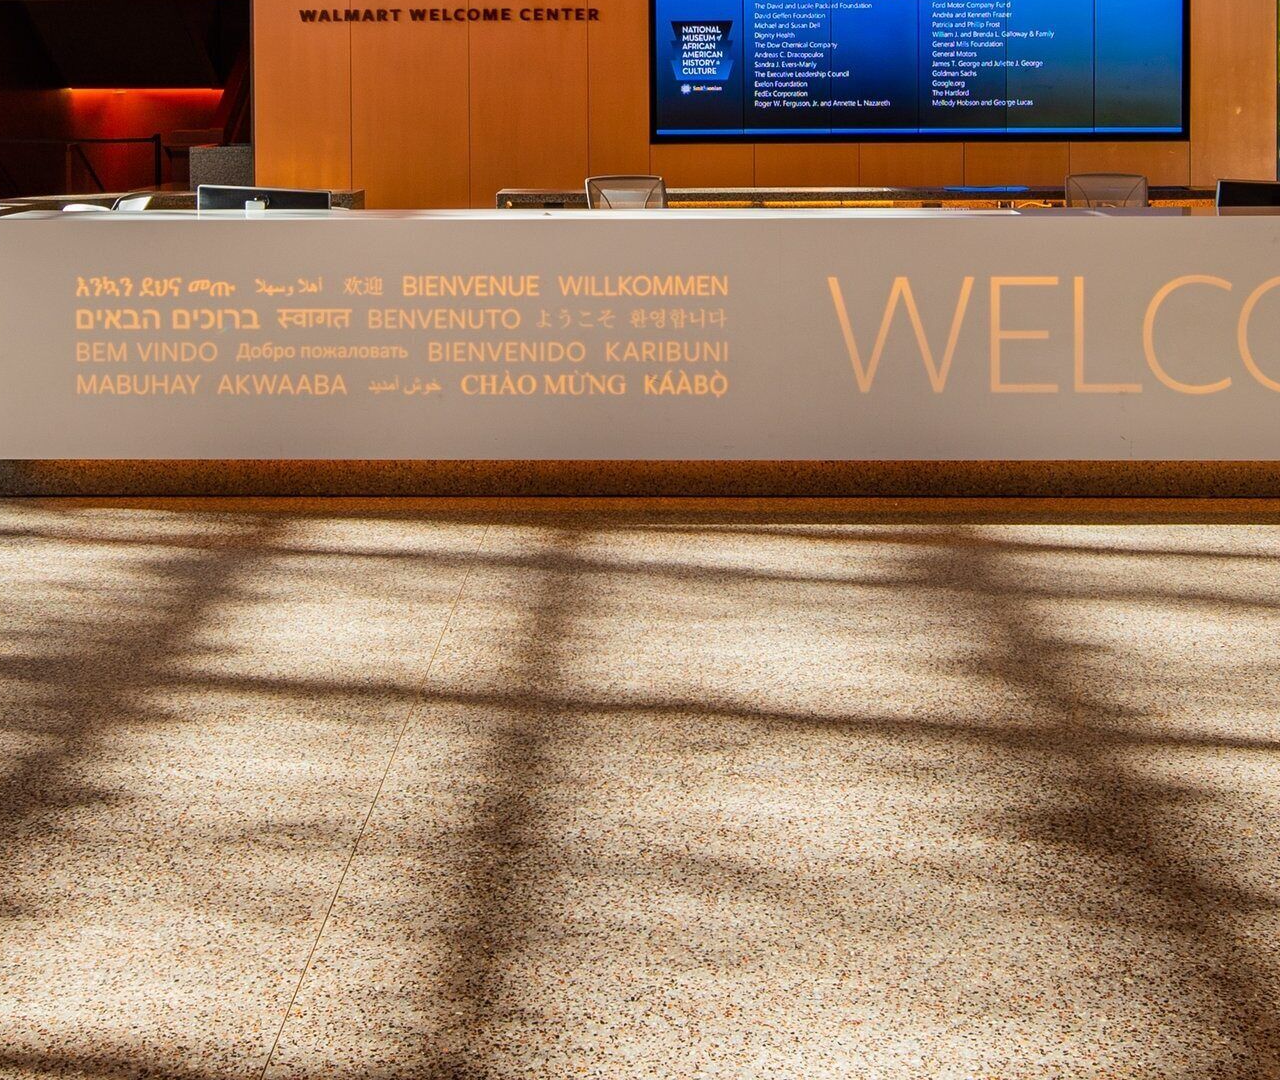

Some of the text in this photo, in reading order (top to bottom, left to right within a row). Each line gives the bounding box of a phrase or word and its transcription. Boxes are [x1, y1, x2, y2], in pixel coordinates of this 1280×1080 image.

[299, 8, 600, 22] WALMART WELCOME CENTER
[966, 2, 994, 10] Company
[754, 32, 774, 40] Dignity
[958, 60, 980, 68] George
[754, 100, 772, 108] Roger
[342, 276, 385, 296] 欢迎
[402, 275, 540, 297] BIENVENUE
[557, 275, 728, 297] WILLKOMMEN
[76, 309, 261, 329] ברוכים הבאים
[277, 308, 352, 329] स्वागत
[368, 309, 521, 329] BENVENUTO
[536, 308, 616, 329] ようこそ
[630, 308, 728, 329] 환영합니다
[76, 342, 218, 362] BEM VINDO
[236, 343, 409, 362] Добро пожаловать
[428, 342, 586, 362] BIENVENIDO
[606, 342, 728, 362] KARIBUNI
[76, 374, 201, 394] MABUHAY
[217, 374, 347, 394] AKWAABA
[460, 370, 537, 395] CHÀO
